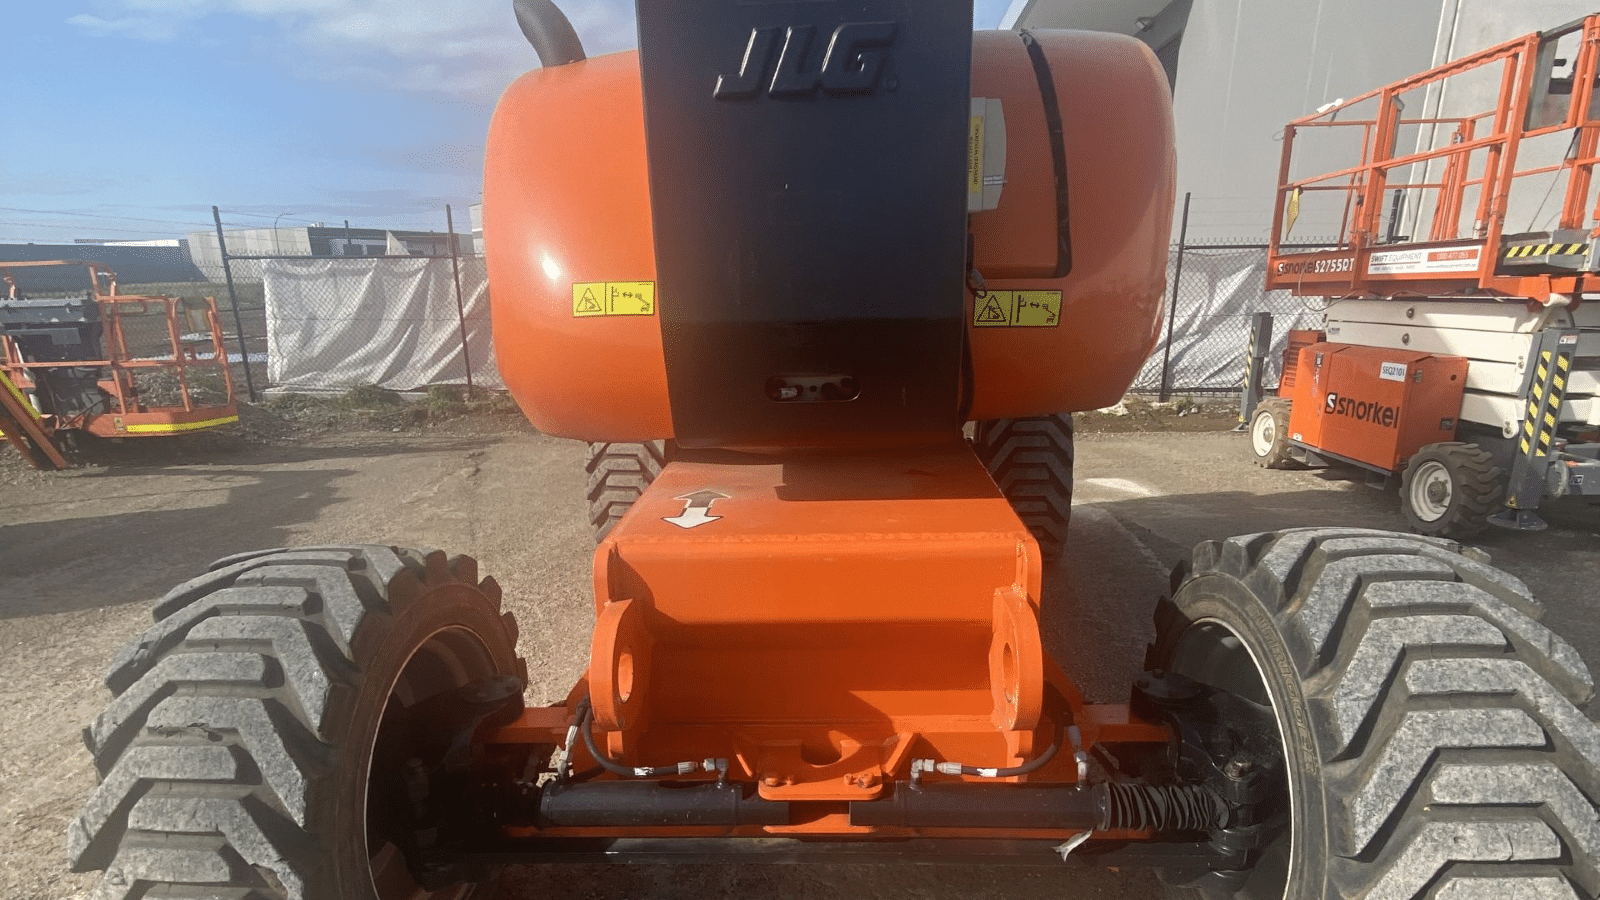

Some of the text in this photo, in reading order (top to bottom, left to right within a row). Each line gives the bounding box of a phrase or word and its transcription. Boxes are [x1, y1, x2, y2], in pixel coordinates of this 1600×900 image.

[713, 21, 898, 100] JLG
[1314, 258, 1355, 273] S2755RT
[1371, 254, 1388, 262] SWIFT
[1382, 366, 1405, 377] SEQ2101
[1337, 397, 1400, 429] snorkel
